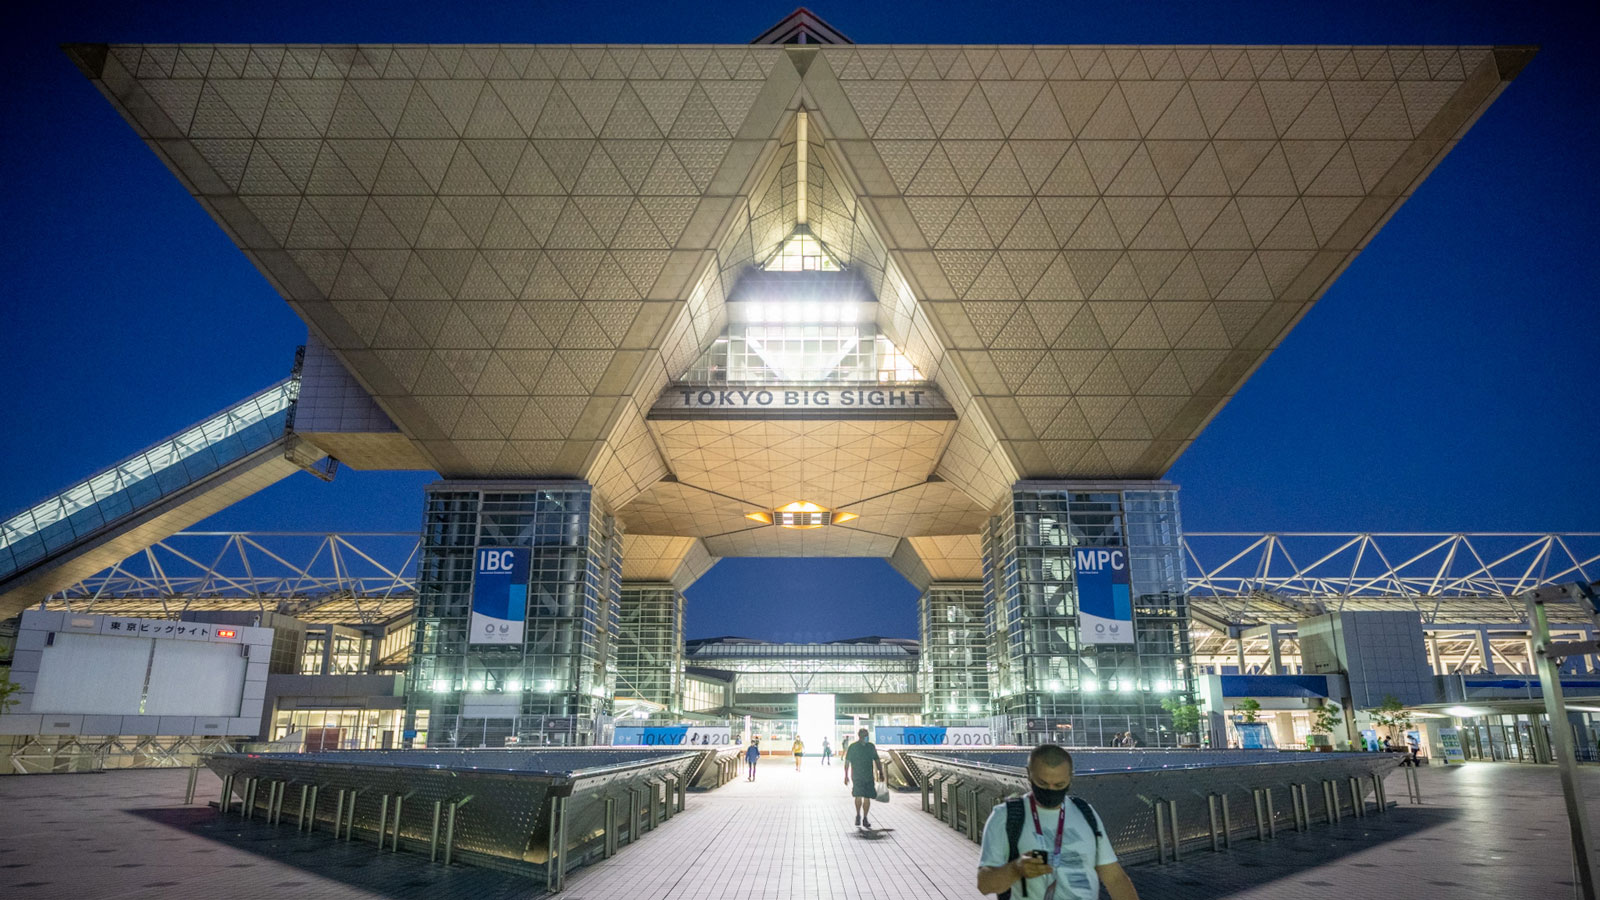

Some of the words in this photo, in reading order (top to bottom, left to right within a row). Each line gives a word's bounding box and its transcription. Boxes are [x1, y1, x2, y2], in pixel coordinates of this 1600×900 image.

[680, 390, 774, 406] TOKYO
[784, 390, 830, 406] BIG
[840, 390, 925, 406] SIGHT
[480, 550, 514, 571] IBC
[1077, 550, 1124, 571] MPC
[110, 621, 209, 636] 東京ビッグサイト
[636, 733, 688, 745] TOKYO
[897, 733, 949, 745] TOKYO
[953, 733, 992, 745] 2020
